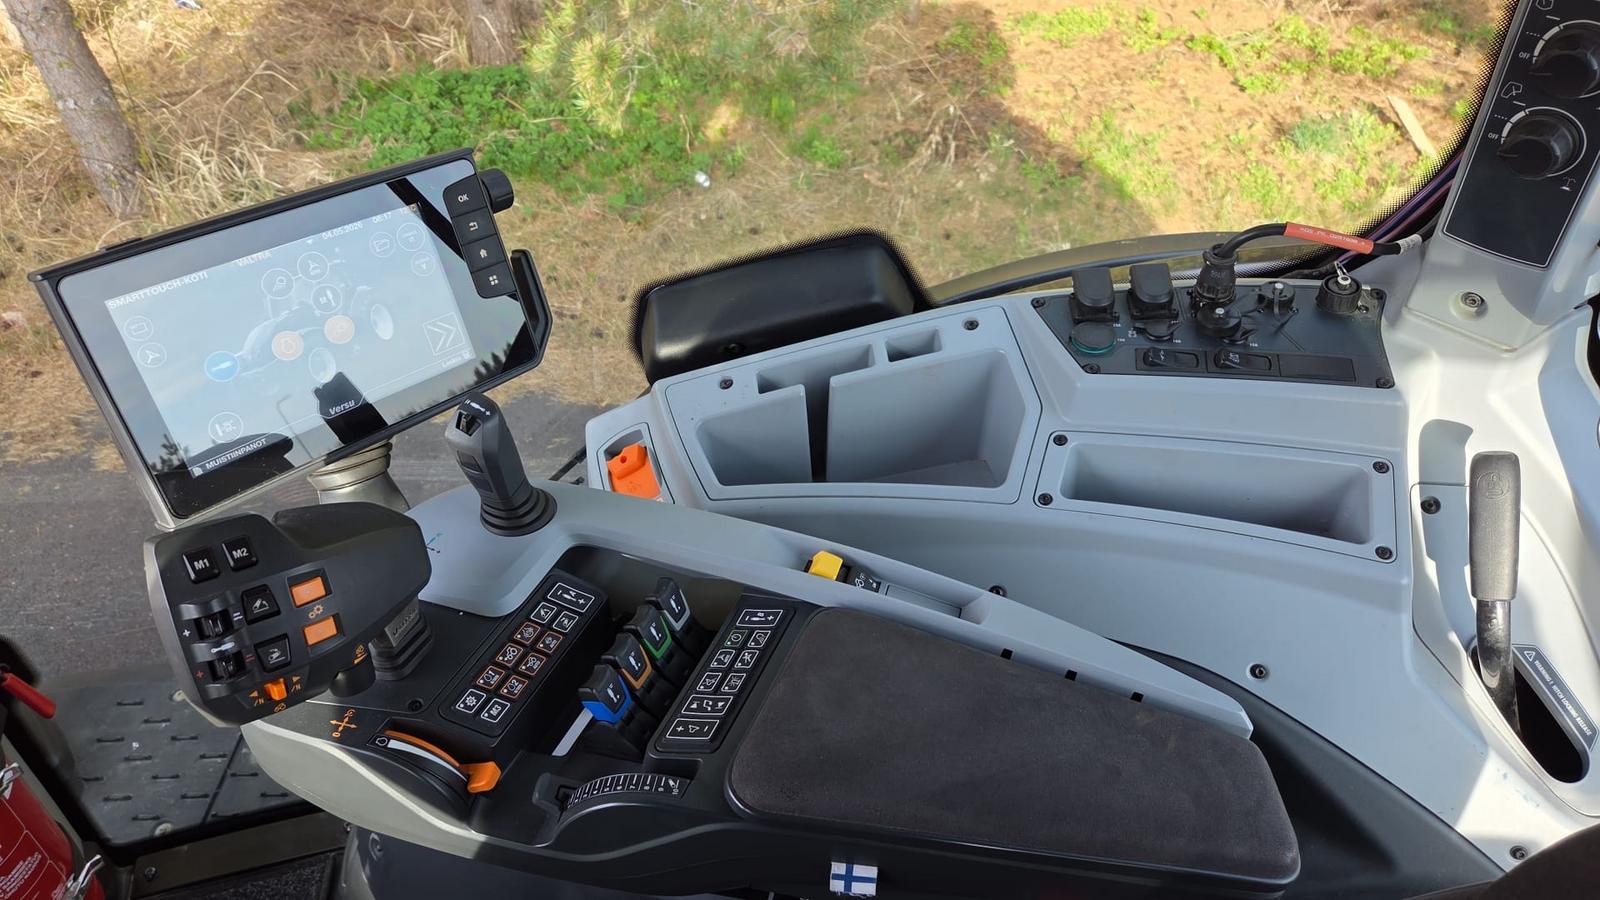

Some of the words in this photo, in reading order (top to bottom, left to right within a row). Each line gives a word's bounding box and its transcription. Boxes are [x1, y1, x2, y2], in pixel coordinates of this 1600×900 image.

[1518, 51, 1531, 61] OFF
[1487, 131, 1499, 141] OFF
[457, 193, 470, 203] OK
[107, 271, 209, 310] SMARTTOUCH-KOTI
[328, 399, 356, 416] Versu
[205, 437, 267, 470] MUISTIINPANOT
[231, 547, 249, 560] M2
[193, 558, 210, 570] M1
[489, 704, 502, 717] M3
